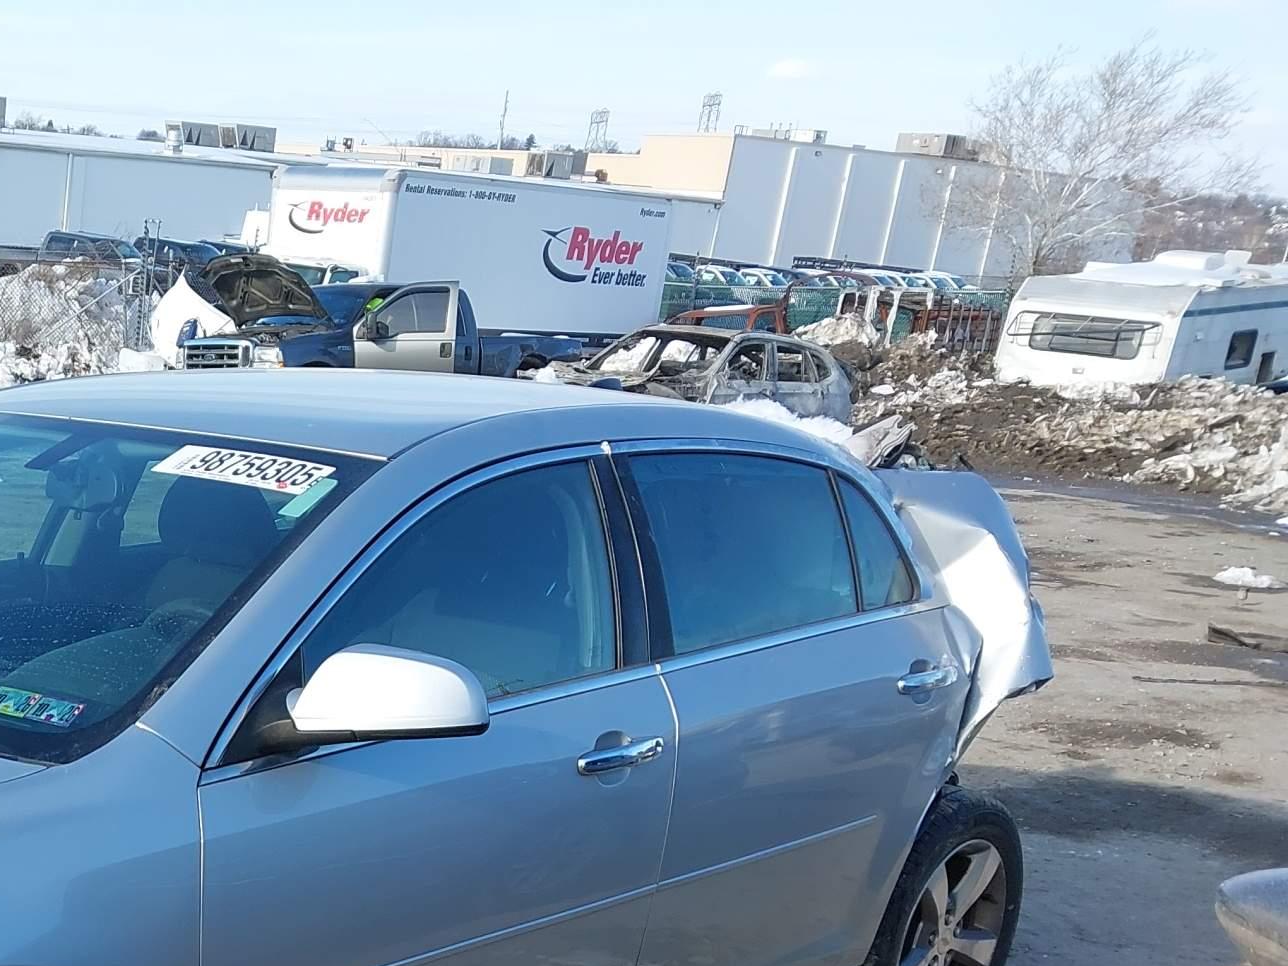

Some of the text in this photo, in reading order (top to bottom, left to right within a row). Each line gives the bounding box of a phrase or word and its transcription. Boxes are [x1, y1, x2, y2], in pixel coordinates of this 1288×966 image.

[307, 201, 370, 226] Ryder
[640, 208, 666, 218] Ryder.com
[566, 226, 644, 270] Ryder
[591, 267, 647, 287] Ever better.
[190, 450, 323, 487] 98759305
